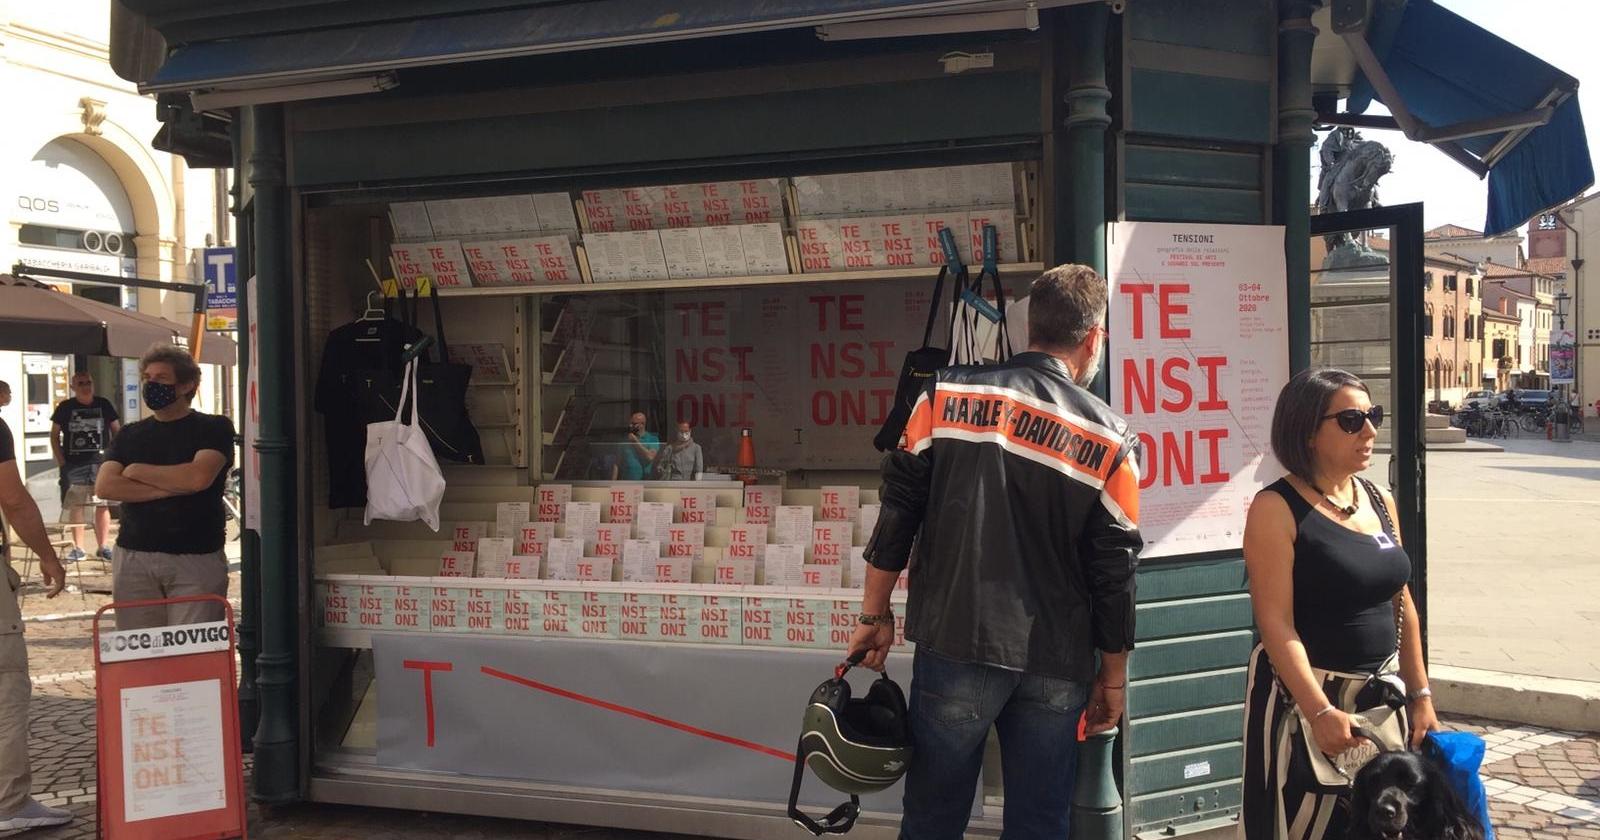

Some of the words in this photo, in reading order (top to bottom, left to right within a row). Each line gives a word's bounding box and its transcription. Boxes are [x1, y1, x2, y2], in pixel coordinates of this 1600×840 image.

[663, 188, 679, 199] TE
[702, 185, 718, 197] TE
[740, 182, 757, 194] TE
[585, 192, 600, 204] TE
[623, 190, 640, 202] TE
[664, 202, 689, 214] NSI
[703, 200, 730, 211] NSI
[742, 197, 769, 208] NSI
[588, 206, 612, 218] NSI
[626, 204, 650, 216] NSI
[841, 226, 859, 237] TE
[882, 224, 901, 236] TE
[926, 221, 945, 233] TE
[800, 228, 816, 240] TE
[1173, 235, 1214, 244] TENSIONI
[535, 244, 552, 255] TE
[802, 242, 828, 254] NSI
[844, 240, 870, 252] NSI
[885, 238, 912, 250] NSI
[395, 250, 410, 261] TE
[427, 248, 444, 259] TE
[466, 248, 482, 259] TE
[502, 246, 518, 257] TE
[506, 259, 529, 269] NSI
[540, 256, 565, 268] NSI
[805, 257, 831, 269] ONI
[847, 255, 873, 267] ONI
[887, 253, 914, 266] ONI
[399, 264, 422, 274] NSI
[432, 261, 456, 272] NSI
[471, 261, 496, 271] NSI
[208, 254, 232, 294] T
[402, 276, 417, 288] ON
[809, 295, 865, 331] TE
[1120, 283, 1191, 339] TE
[674, 301, 725, 336] TE
[676, 347, 754, 383] NSI
[811, 341, 896, 378] NSI
[1123, 356, 1228, 415] NSI
[942, 396, 1108, 470] HARLEY-DAVIDSON
[541, 491, 554, 501] TE
[610, 492, 624, 502] TE
[747, 492, 762, 503] TE
[823, 493, 838, 504] TE
[539, 504, 560, 514] NSI
[681, 498, 696, 509] TE
[610, 506, 632, 516] NSI
[681, 512, 704, 522] NSI
[747, 507, 769, 518] NSI
[822, 508, 846, 519] NSI
[456, 528, 469, 538] TE
[522, 529, 535, 539] TE
[597, 530, 611, 540] TE
[670, 530, 684, 541] TE
[731, 530, 747, 542] TE
[815, 529, 831, 540] TE
[455, 543, 474, 552] NSI
[521, 544, 542, 553] NSI
[595, 544, 618, 554] NSI
[669, 545, 692, 556] NSI
[730, 545, 754, 556] NSI
[814, 544, 839, 555] NSI
[442, 558, 456, 568] TE
[506, 563, 520, 573] TE
[578, 564, 592, 575] TE
[656, 565, 671, 576] TE
[718, 568, 733, 579] TE
[804, 572, 820, 584] TE
[326, 597, 348, 609] NSI
[360, 598, 382, 610] NSI
[395, 599, 417, 610] NSI
[432, 600, 455, 611] NSI
[467, 602, 491, 613] NSI
[505, 603, 529, 615] NSI
[543, 604, 567, 616] NSI
[582, 605, 607, 617] NSI
[622, 607, 647, 618] NSI
[660, 608, 686, 620] NSI
[701, 609, 728, 622] NSI
[326, 611, 348, 624] ONI
[360, 613, 382, 624] ONI
[395, 614, 418, 626] ONI
[432, 615, 455, 627] ONI
[468, 616, 492, 628] ONI
[744, 611, 771, 623] NSI
[787, 612, 814, 625] NSI
[505, 618, 529, 630] ONI
[543, 620, 567, 631] ONI
[582, 620, 607, 633] ONI
[622, 621, 647, 634] ONI
[660, 623, 687, 636] ONI
[162, 626, 230, 647] ROVIGO
[702, 625, 728, 638] ONI
[744, 627, 771, 640] ONI
[787, 628, 814, 642] ONI
[831, 630, 850, 642] ON
[134, 714, 167, 736] TE
[134, 738, 186, 762] NSI
[135, 764, 186, 789] ONI
